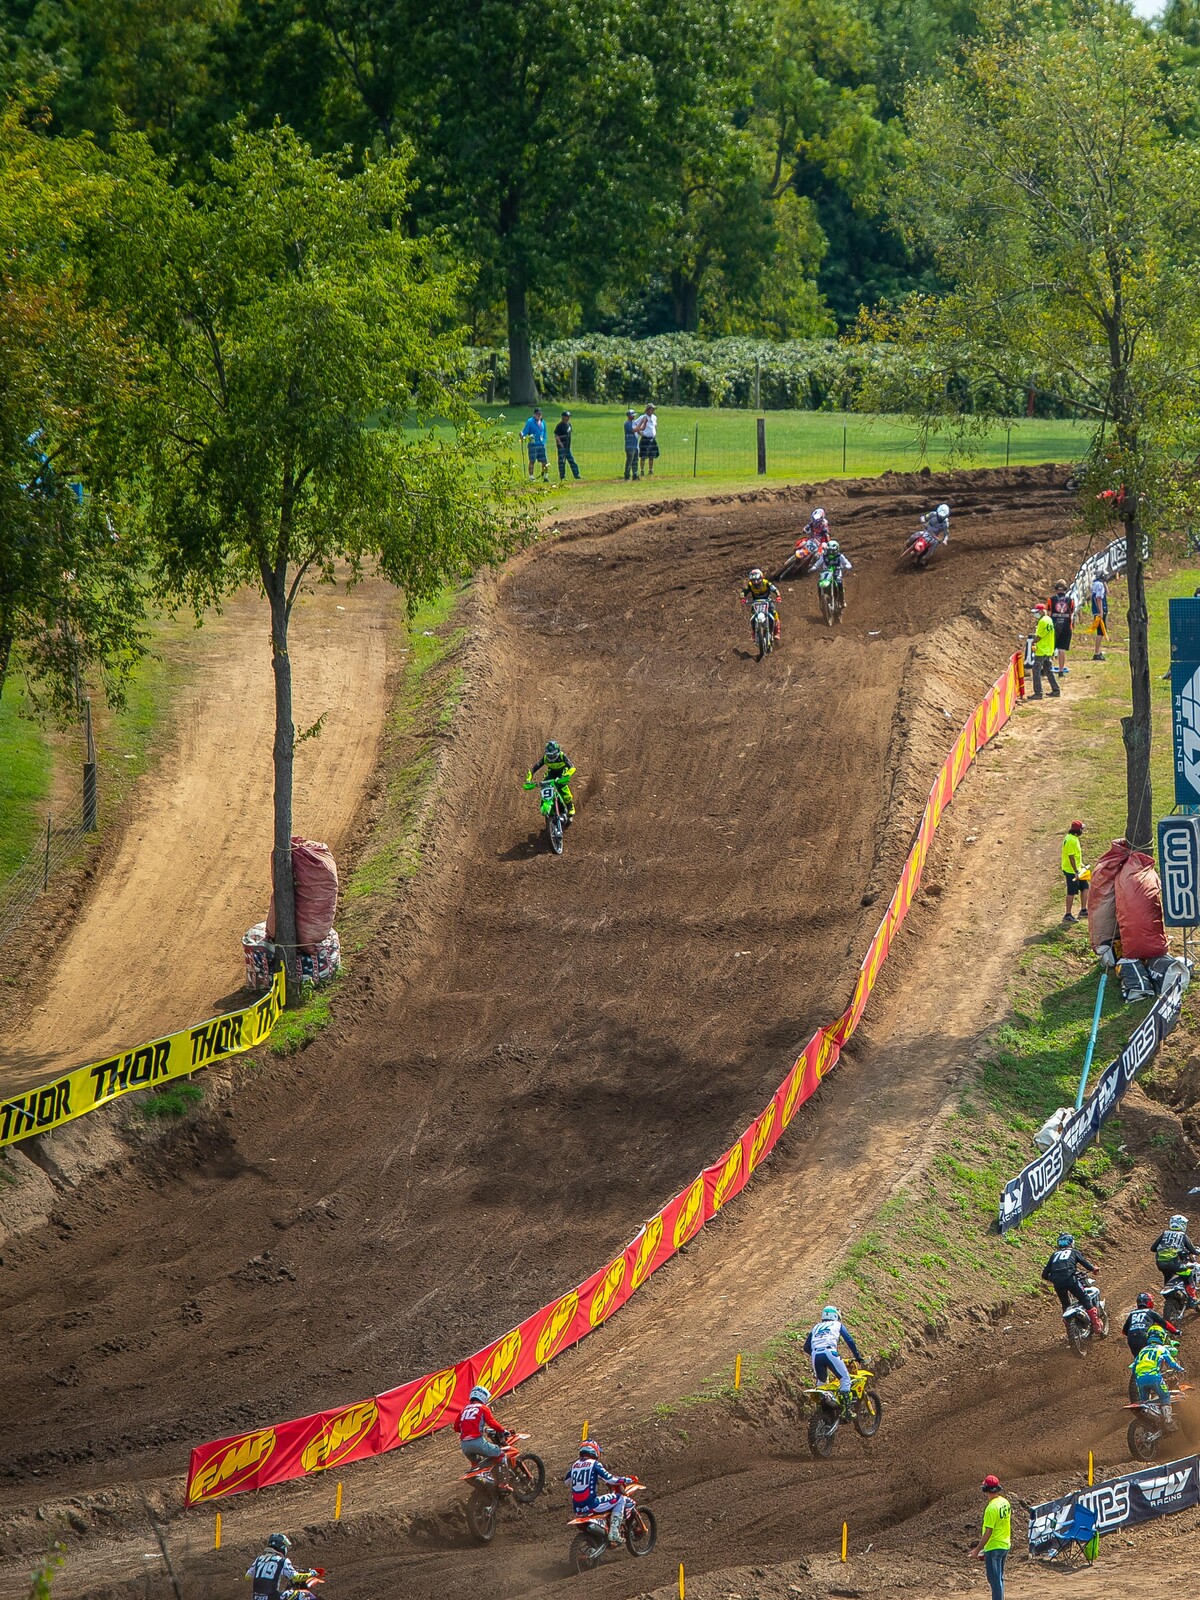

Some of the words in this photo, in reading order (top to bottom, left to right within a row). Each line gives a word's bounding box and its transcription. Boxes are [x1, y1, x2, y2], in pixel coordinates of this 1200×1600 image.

[1174, 694, 1183, 774] RACING
[1164, 828, 1195, 919] WPS
[90, 1040, 172, 1102] THOR
[190, 1016, 244, 1066] THOR
[1122, 1015, 1155, 1080] WPS
[0, 1079, 72, 1140] THOR
[1063, 1098, 1098, 1150] FLY
[1028, 1142, 1063, 1200] WPS
[1053, 1250, 1071, 1263] 78
[536, 1289, 578, 1365] FMF
[399, 1368, 457, 1441] FMF
[189, 1427, 277, 1503] FMF
[302, 1400, 379, 1471] FMF
[571, 1468, 590, 1488] 841
[1138, 1467, 1192, 1501] FLY
[1150, 1493, 1182, 1508] RACING
[256, 1560, 278, 1579] 719
